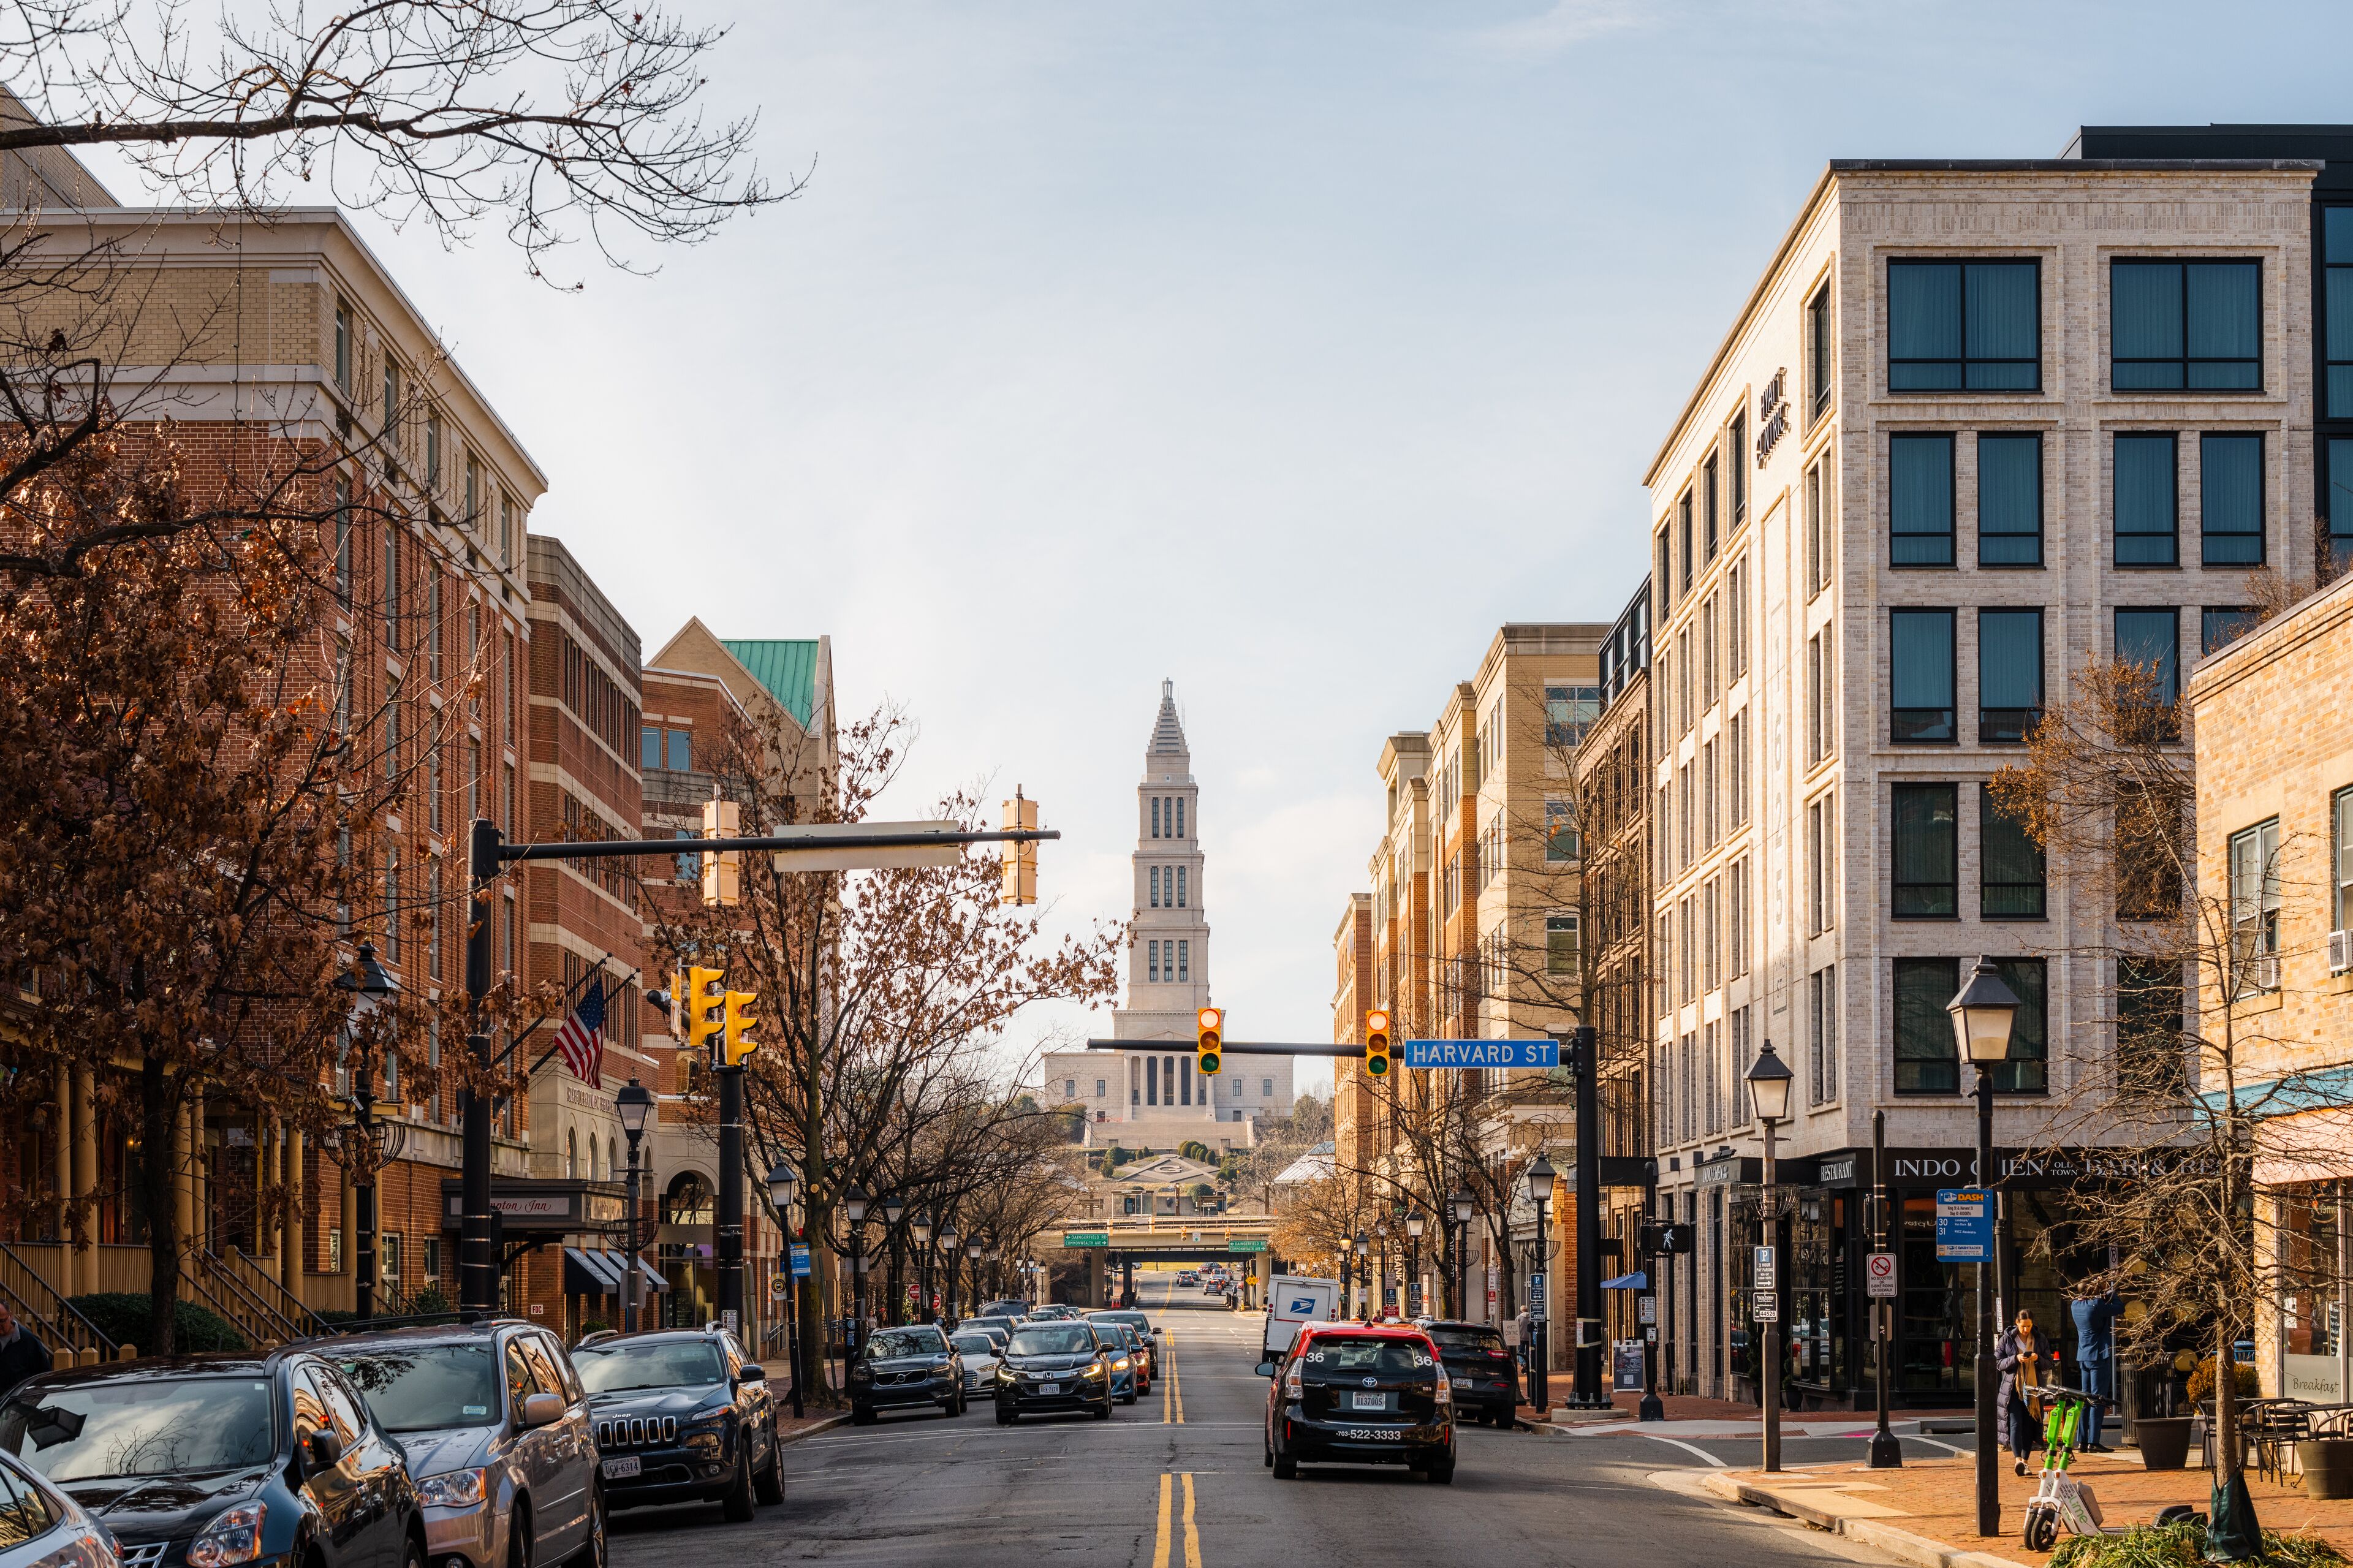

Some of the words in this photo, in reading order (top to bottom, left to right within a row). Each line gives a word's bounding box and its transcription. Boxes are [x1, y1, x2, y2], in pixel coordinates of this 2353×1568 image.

[1761, 367, 1785, 422] HYATT
[1756, 402, 1789, 469] CENTRIC
[1414, 1045, 1514, 1062] HARVARD
[1525, 1045, 1550, 1062] ST
[1703, 1167, 1712, 1183] INDO
[1821, 1161, 1853, 1181] RESTAURANT
[1894, 1159, 1960, 1176] INDO
[2151, 1159, 2169, 1176] &
[525, 1200, 551, 1213] Inn
[1394, 1255, 1403, 1281] BANK
[1306, 1352, 1324, 1363] 36
[1415, 1355, 1433, 1366] 36
[2292, 1377, 2340, 1394] Breakfast
[1356, 1397, 1382, 1406] H137005
[605, 1461, 638, 1474] UCM-6314
[2069, 1496, 2088, 1523] Lime
